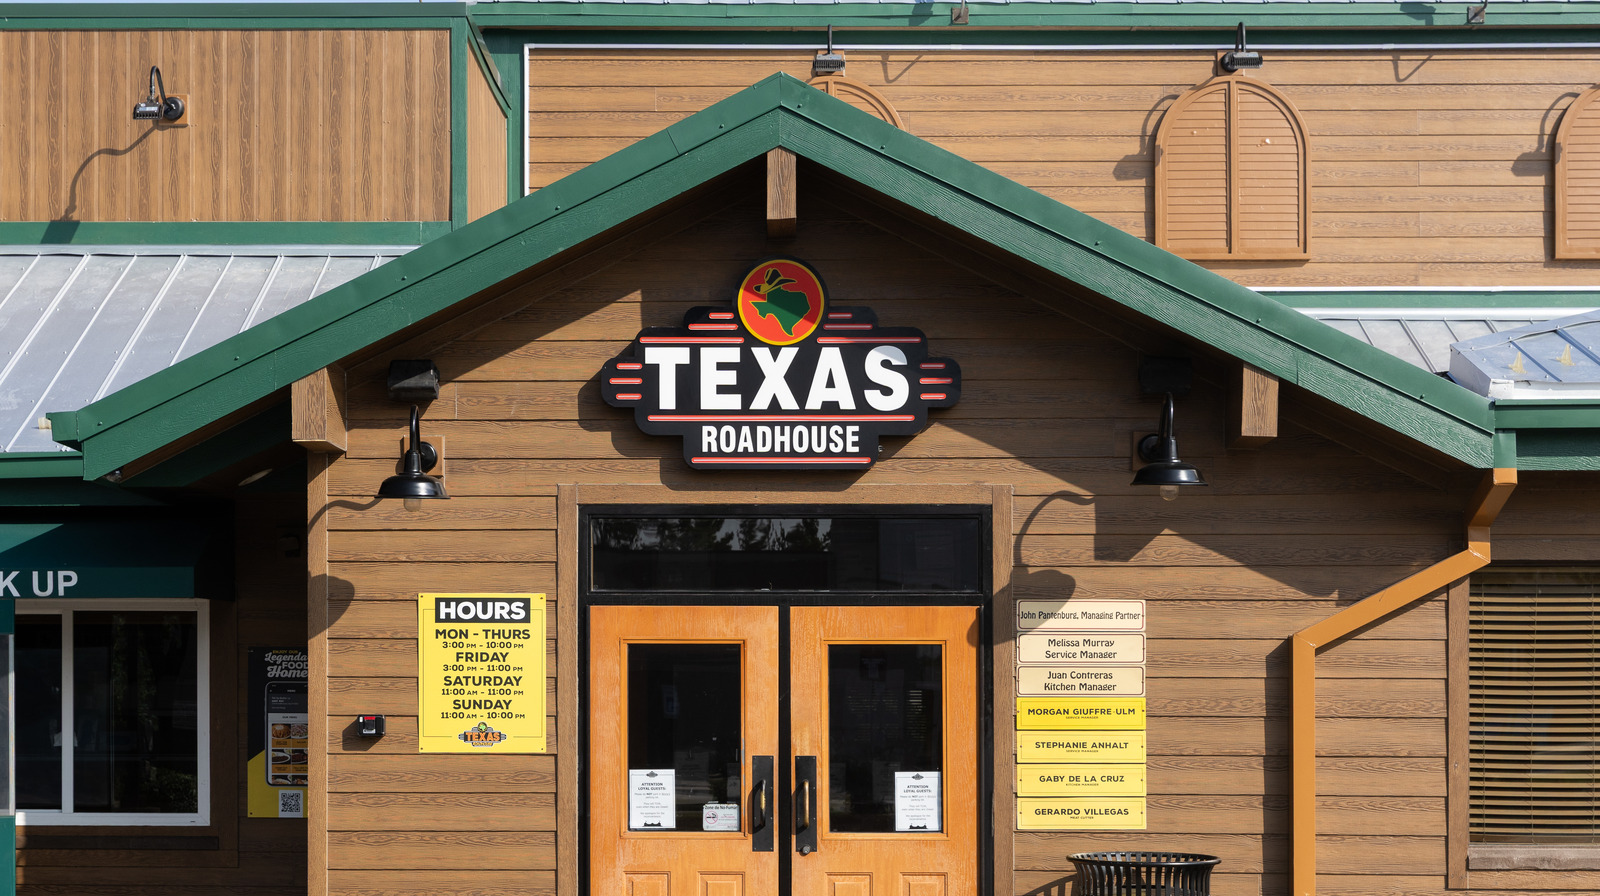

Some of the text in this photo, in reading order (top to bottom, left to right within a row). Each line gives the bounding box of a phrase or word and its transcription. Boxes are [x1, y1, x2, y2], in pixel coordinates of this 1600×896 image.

[645, 346, 910, 412] TEXAS
[702, 425, 860, 452] ROADHOUSE
[32, 570, 78, 597] UP
[440, 601, 526, 620] HOURS
[1020, 611, 1036, 619] John
[1081, 611, 1113, 619] Managing
[1115, 611, 1140, 619] Partner
[435, 628, 468, 640] MON
[482, 628, 530, 640] THURS
[1048, 639, 1114, 647] Melissa Murray
[264, 652, 308, 664] Legenda
[456, 652, 509, 662] FRIDAY
[1045, 650, 1117, 659] Service Manager
[1047, 671, 1113, 679] Juan Contreras
[444, 676, 522, 686] SATURDAY
[1044, 683, 1116, 691] Kitchen Manager
[453, 700, 512, 710] SUNDAY
[466, 732, 500, 741] TEXAS
